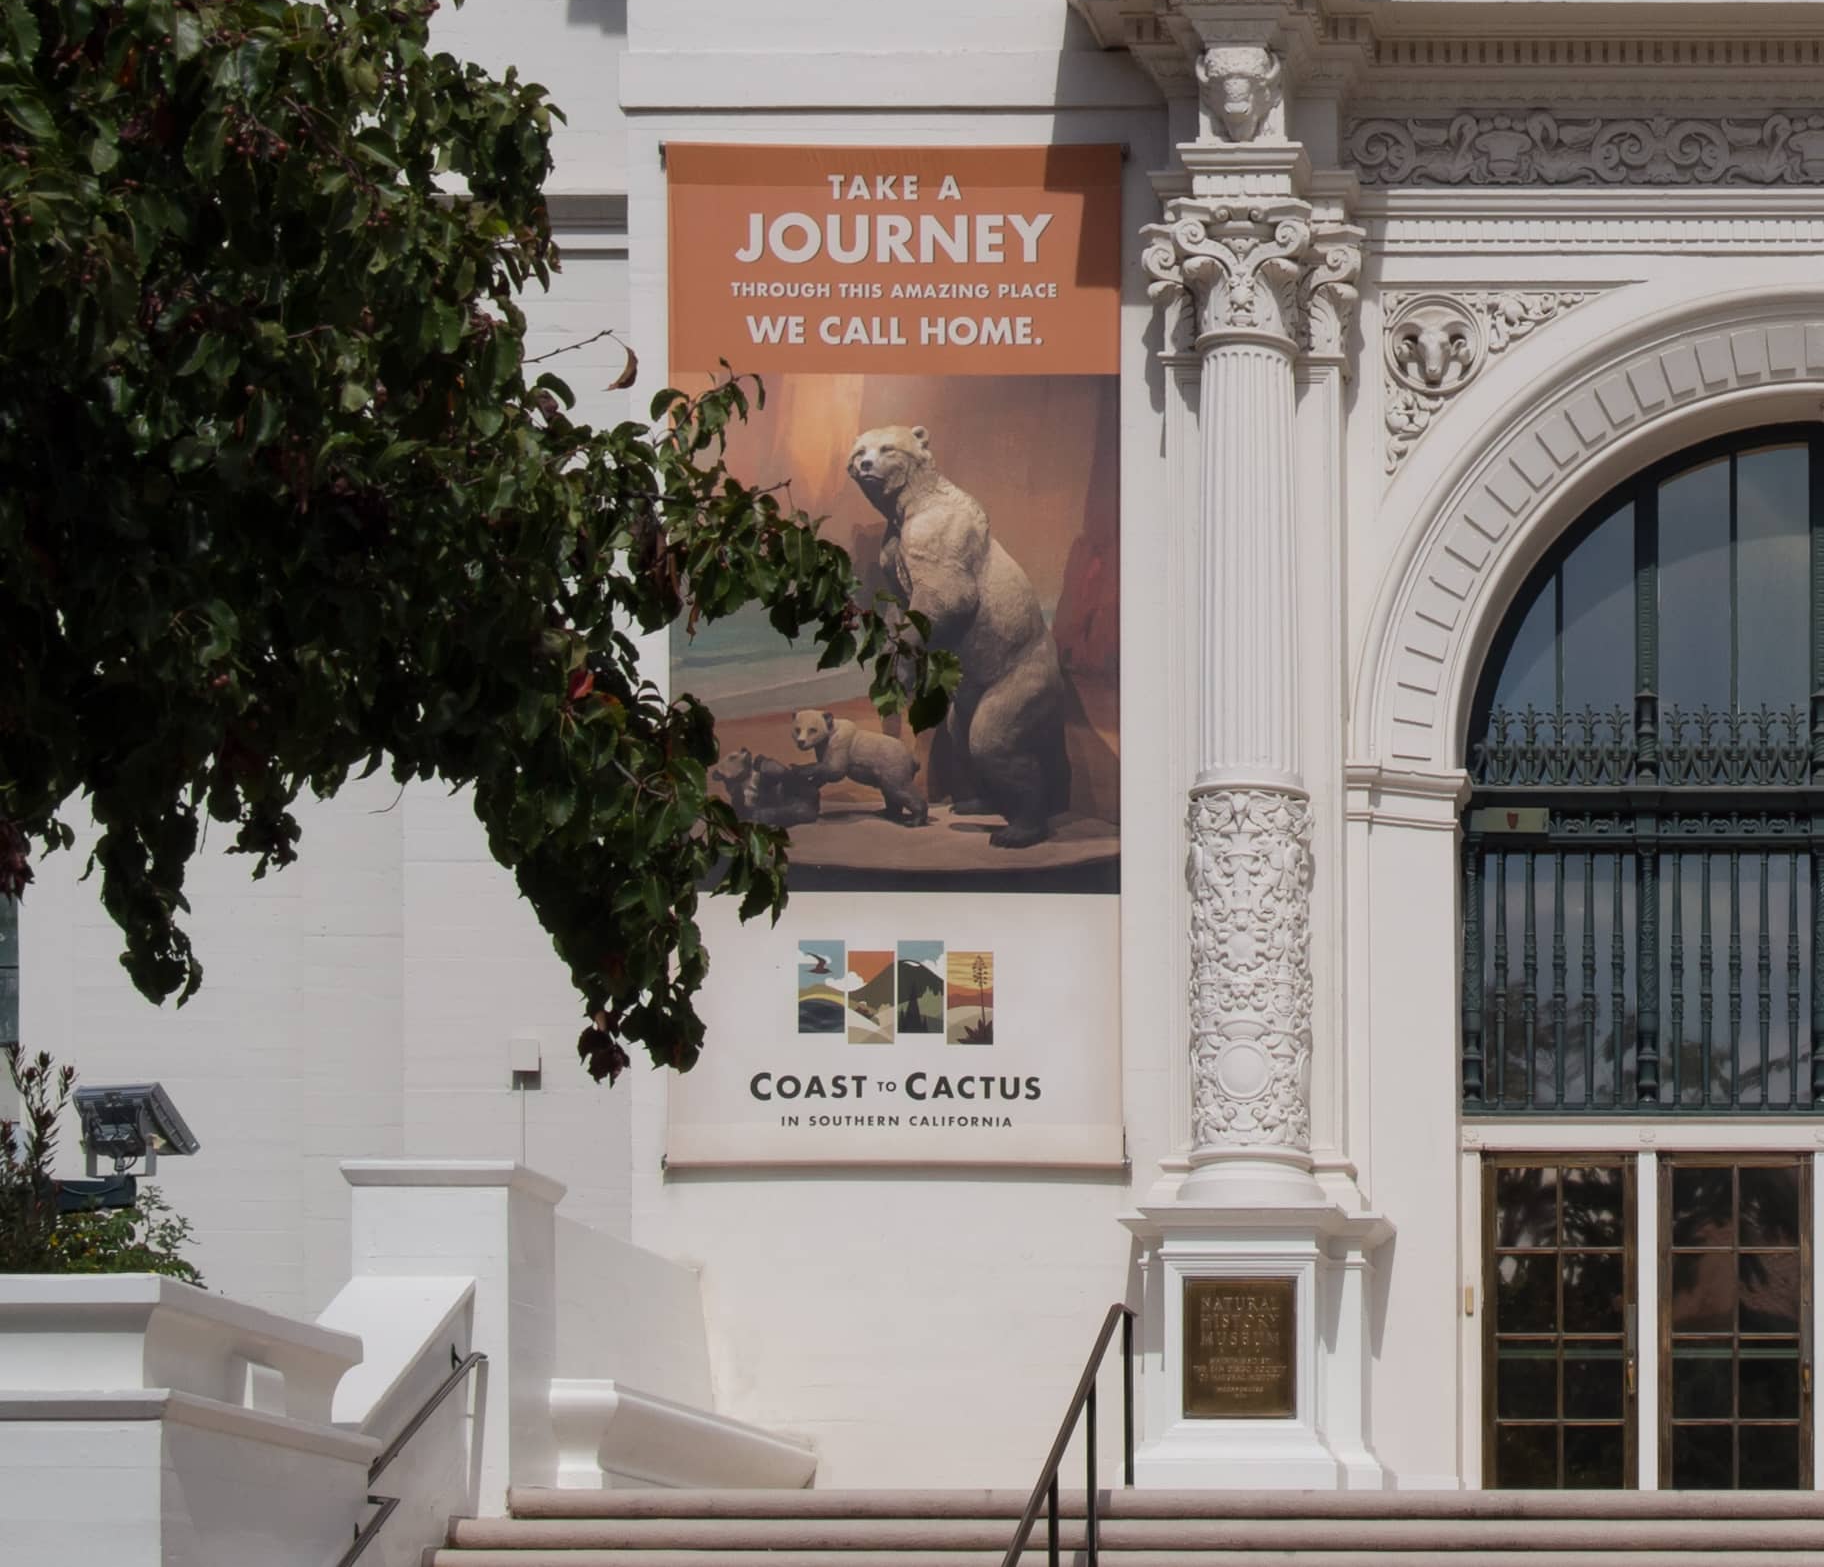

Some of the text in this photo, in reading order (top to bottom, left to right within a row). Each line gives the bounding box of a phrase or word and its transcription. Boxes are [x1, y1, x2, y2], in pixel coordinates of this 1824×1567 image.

[828, 175, 961, 200] TAKE A
[735, 213, 1052, 263] JOURNEY
[731, 282, 1056, 298] THROUGH THIS AMAZING PLACE
[747, 316, 1041, 345] WE CALL HOME.
[877, 1082, 896, 1092] TO
[782, 1116, 1011, 1127] IN SOUTHERN CALIFORNIA
[1201, 1297, 1280, 1311] NATURAL
